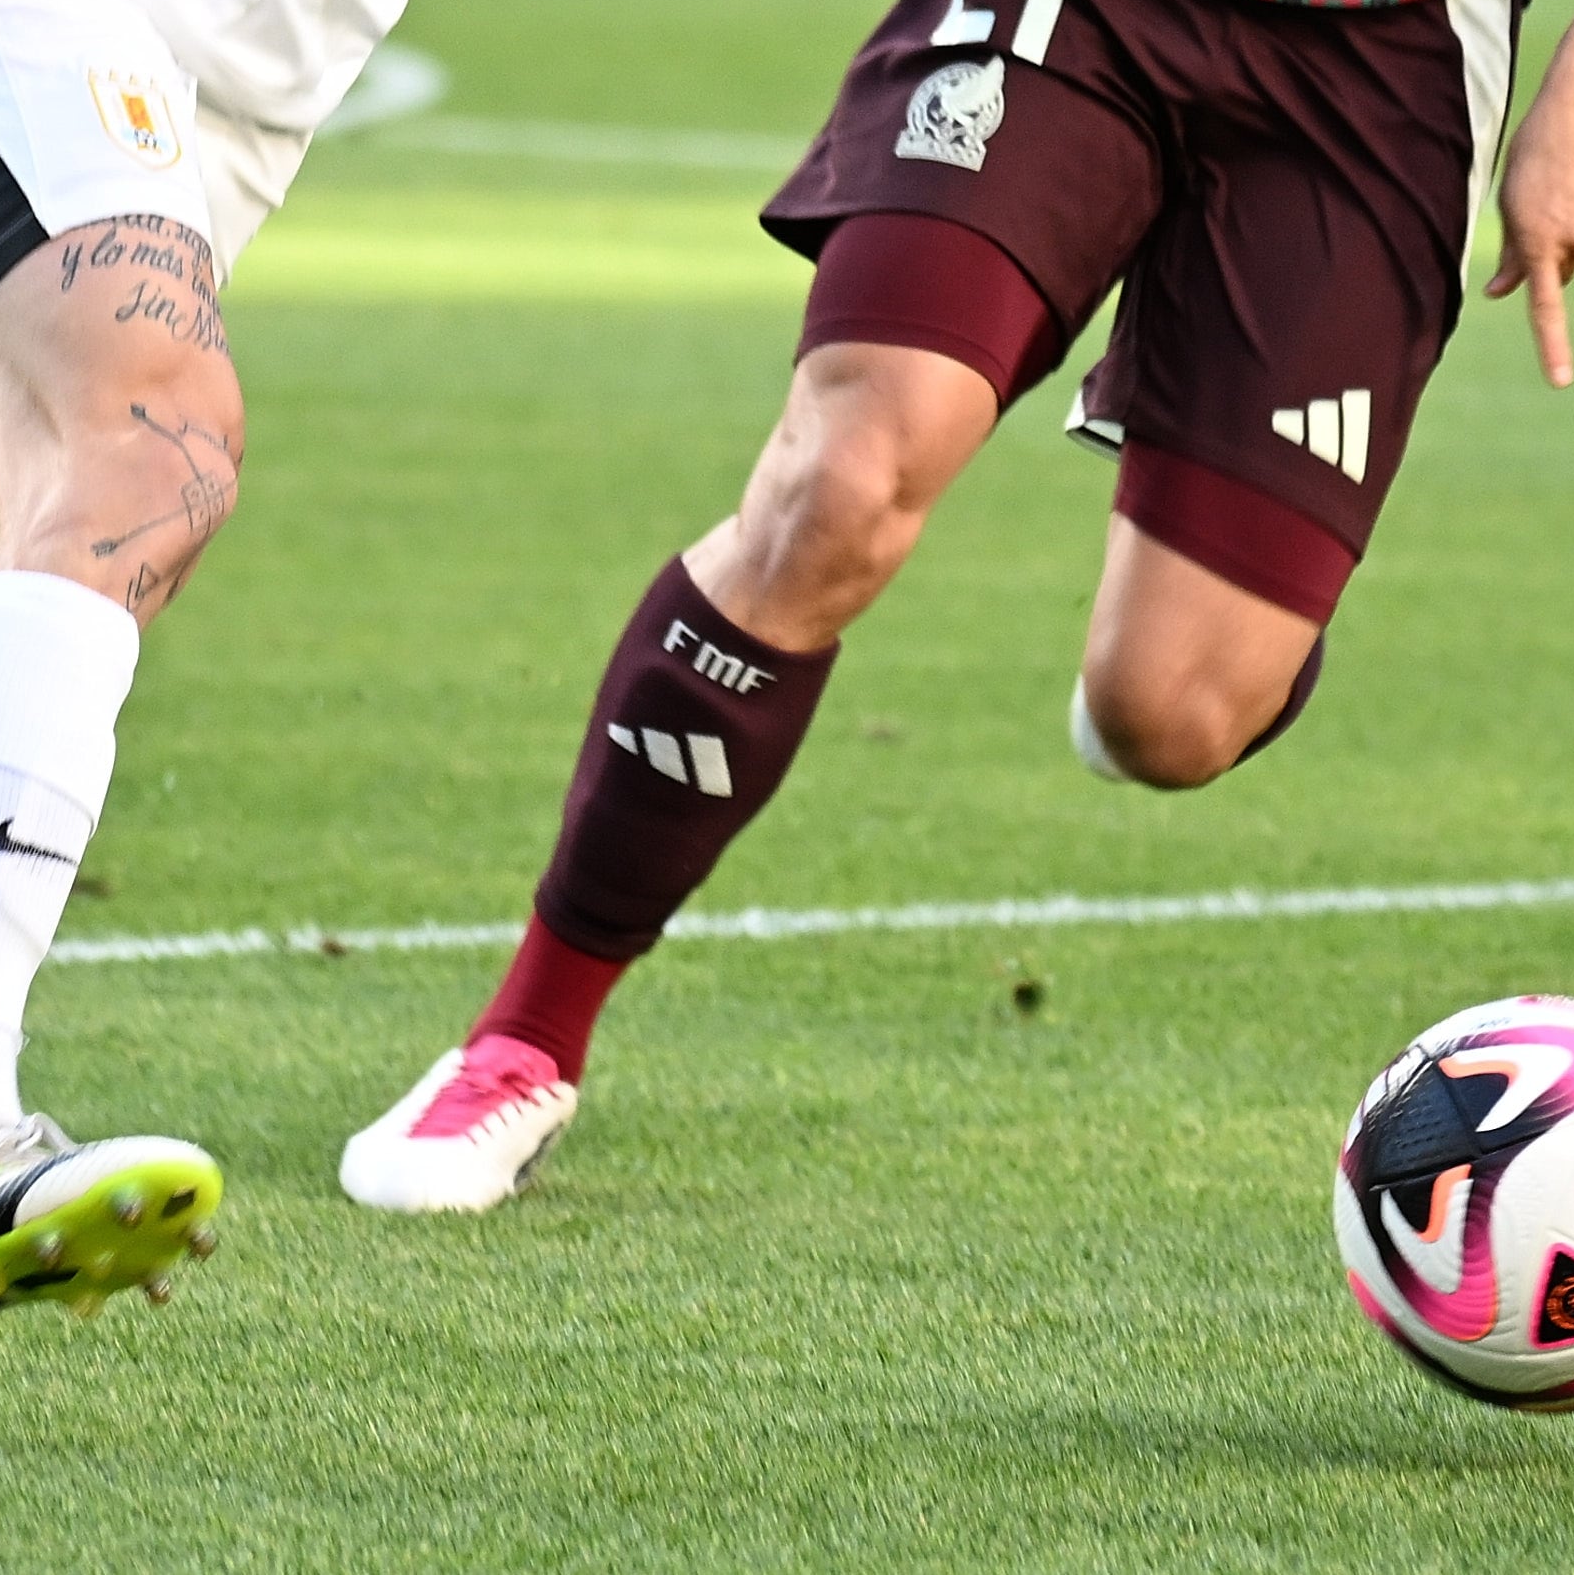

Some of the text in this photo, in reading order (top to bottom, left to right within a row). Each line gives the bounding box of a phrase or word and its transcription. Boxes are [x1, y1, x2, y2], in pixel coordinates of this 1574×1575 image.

[61, 241, 83, 293] y
[91, 226, 126, 269] lo
[662, 618, 778, 695] FMF
